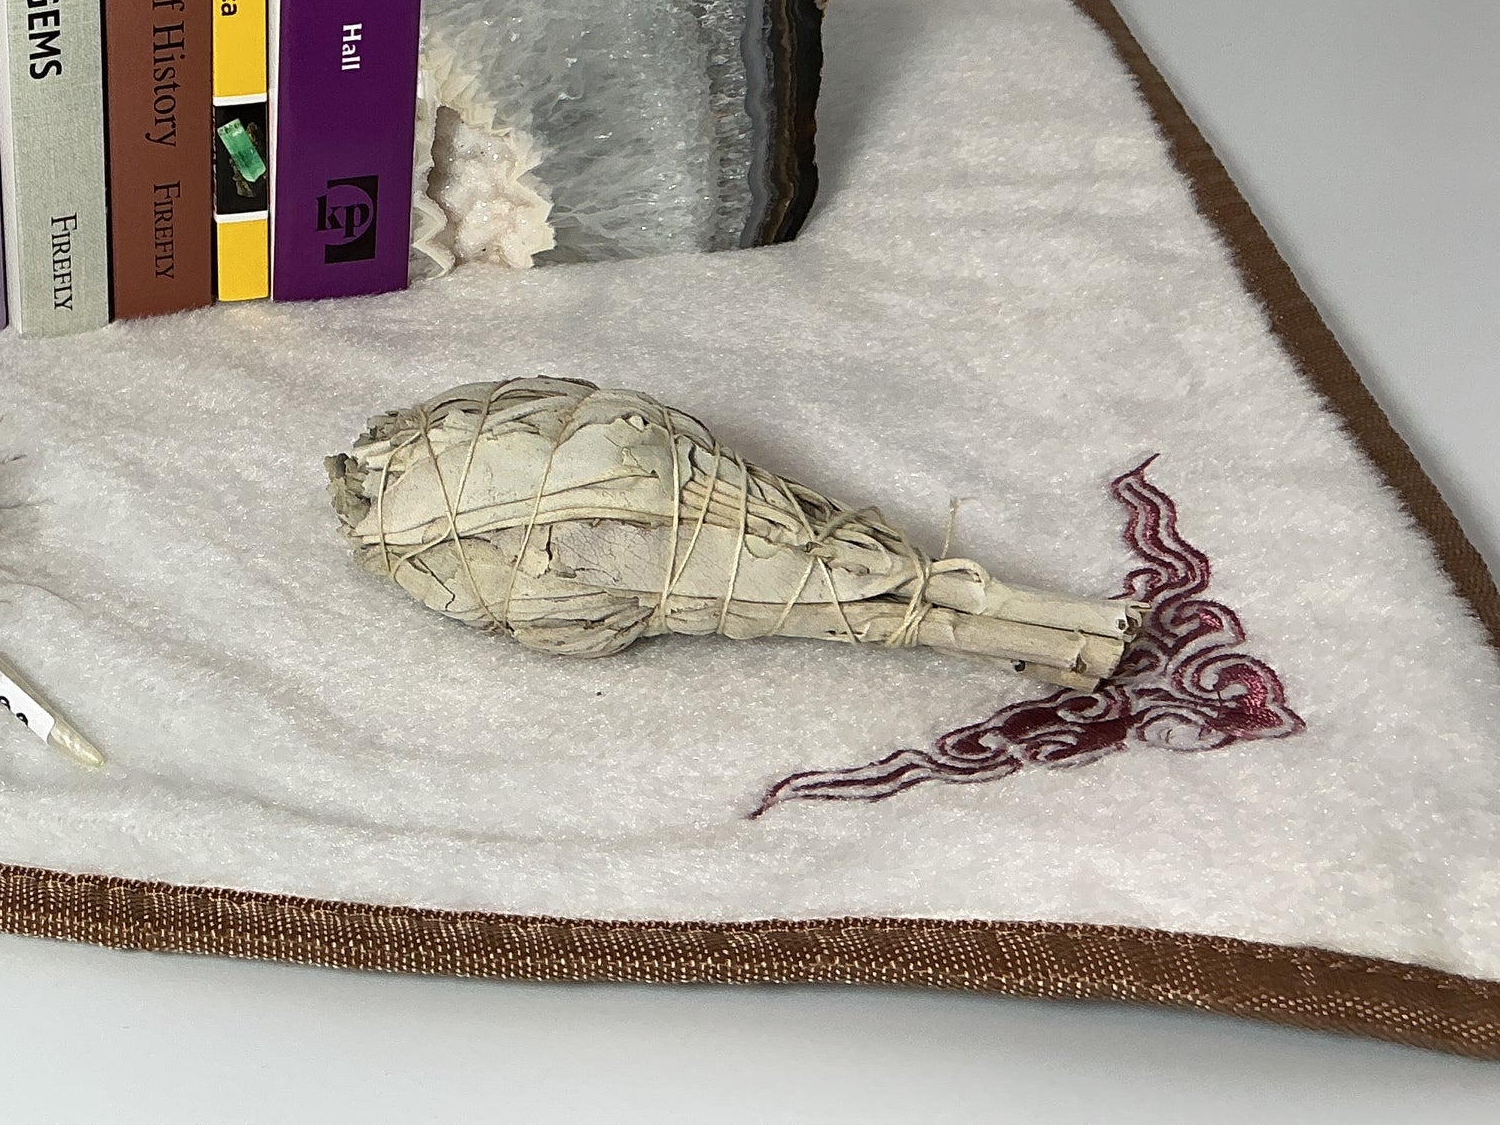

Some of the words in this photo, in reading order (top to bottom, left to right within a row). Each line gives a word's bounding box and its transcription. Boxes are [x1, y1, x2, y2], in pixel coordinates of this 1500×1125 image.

[145, 20, 186, 148] History
[341, 22, 362, 71] Hall
[51, 212, 78, 311] FIREFLY
[153, 180, 181, 280] FIREFLY
[315, 195, 371, 239] kp
